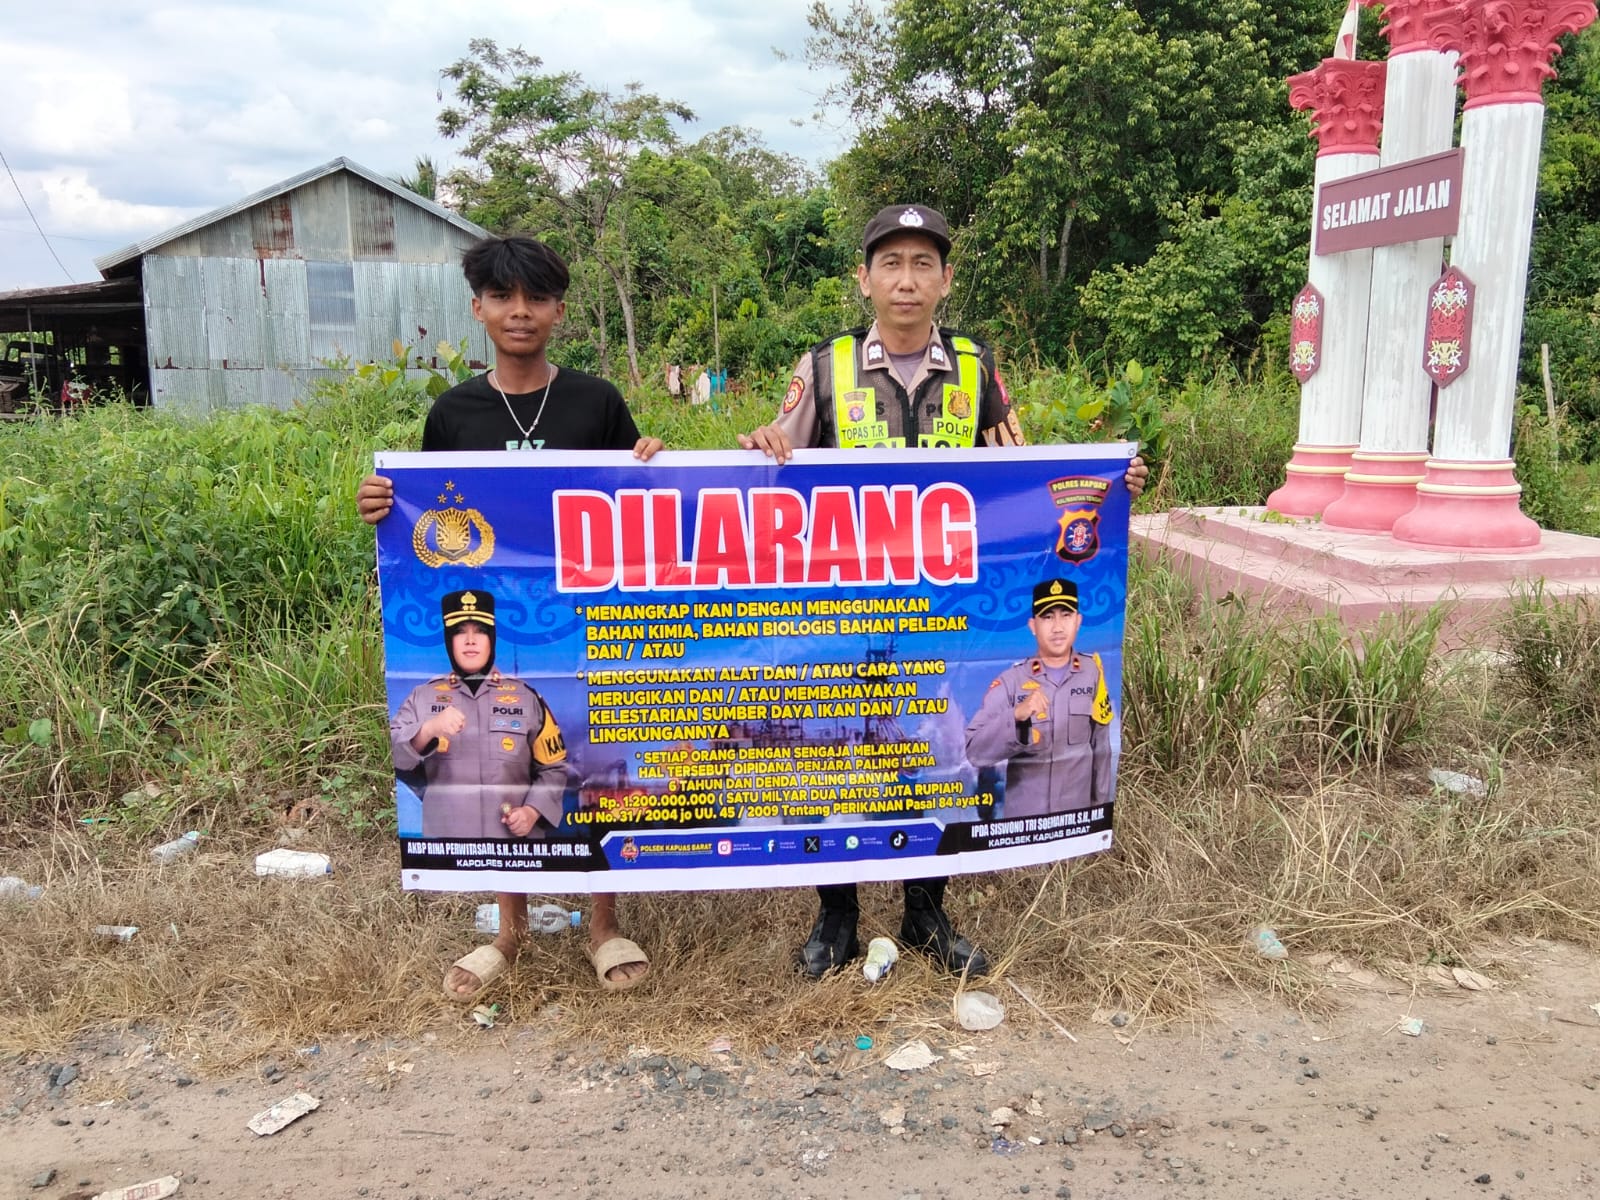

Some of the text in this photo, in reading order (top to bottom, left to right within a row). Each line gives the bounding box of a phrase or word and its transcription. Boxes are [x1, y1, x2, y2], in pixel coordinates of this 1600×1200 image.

[1322, 179, 1450, 230] SELAMAT JALAN
[841, 424, 884, 440] TOPAS T.R
[936, 421, 973, 438] POLRI
[553, 482, 979, 592] DILARANG
[586, 598, 930, 621] MENANGKAP IKAN DENGAN MENGGUNAKAN
[586, 616, 968, 641] BAHAN KIMIA, BAHAN BIOLOGIS BAHAN PELEDAK
[586, 645, 622, 660] DAN
[642, 642, 685, 658] ATAU
[588, 668, 715, 686] MENGGUNAKAN
[720, 667, 759, 682] ALAT
[764, 666, 796, 680] DAN
[812, 664, 852, 679] ATAU
[856, 662, 900, 677] CARA
[903, 660, 946, 676] YANG
[588, 690, 685, 706] MERUGIKAN
[689, 689, 724, 704] DAN
[739, 688, 780, 702] ATAU
[784, 682, 916, 700] MEMBAHAYAKAN
[1070, 687, 1093, 696] POLRI
[492, 706, 522, 715] POLRI
[589, 708, 698, 725] KELESTARIAN
[702, 705, 768, 722] SUMBER
[772, 704, 814, 719] DAYA
[818, 703, 857, 718] IKAN
[860, 701, 892, 716] DAN
[908, 698, 948, 714] ATAU
[590, 724, 730, 744] LINGKUNGANNYA
[644, 742, 929, 764] SETIAP ORANG DENGAN SENGAJA MELAKUKAN
[638, 756, 936, 778] HAL TERSEBUT DIPIDANA PENJARA PALING LAMA
[668, 772, 899, 792] 6 TAHUN DAN DENDA PALING BANYAK
[600, 797, 620, 810] Rp.
[623, 793, 716, 808] 1.200.000.000
[726, 792, 758, 804] SATU
[762, 789, 808, 802] MILYAR
[810, 789, 836, 801] DUA
[840, 787, 880, 800] RATUS
[882, 785, 912, 798] JUTA
[915, 782, 964, 796] RUPIAH)
[574, 812, 593, 824] UU
[596, 812, 616, 822] No.
[620, 810, 634, 822] 31
[644, 808, 678, 820] 2004
[680, 810, 692, 823] jo
[694, 808, 717, 819] UU.
[720, 806, 736, 818] 45
[747, 804, 778, 816] 2009
[782, 804, 830, 818] Tentang
[834, 800, 904, 814] PERIKANAN
[906, 798, 936, 810] Pasal
[939, 796, 954, 808] 84
[956, 795, 980, 809] ayat
[982, 793, 994, 807] 2)
[972, 825, 989, 838] IPDA
[990, 822, 1024, 836] SISWONO
[1025, 820, 1036, 832] TRI
[988, 826, 1090, 848] KAPOLSEK KAPUAS BARAT
[408, 842, 426, 854] AKBP
[456, 859, 542, 868] KAPOLRES KAPUAS
